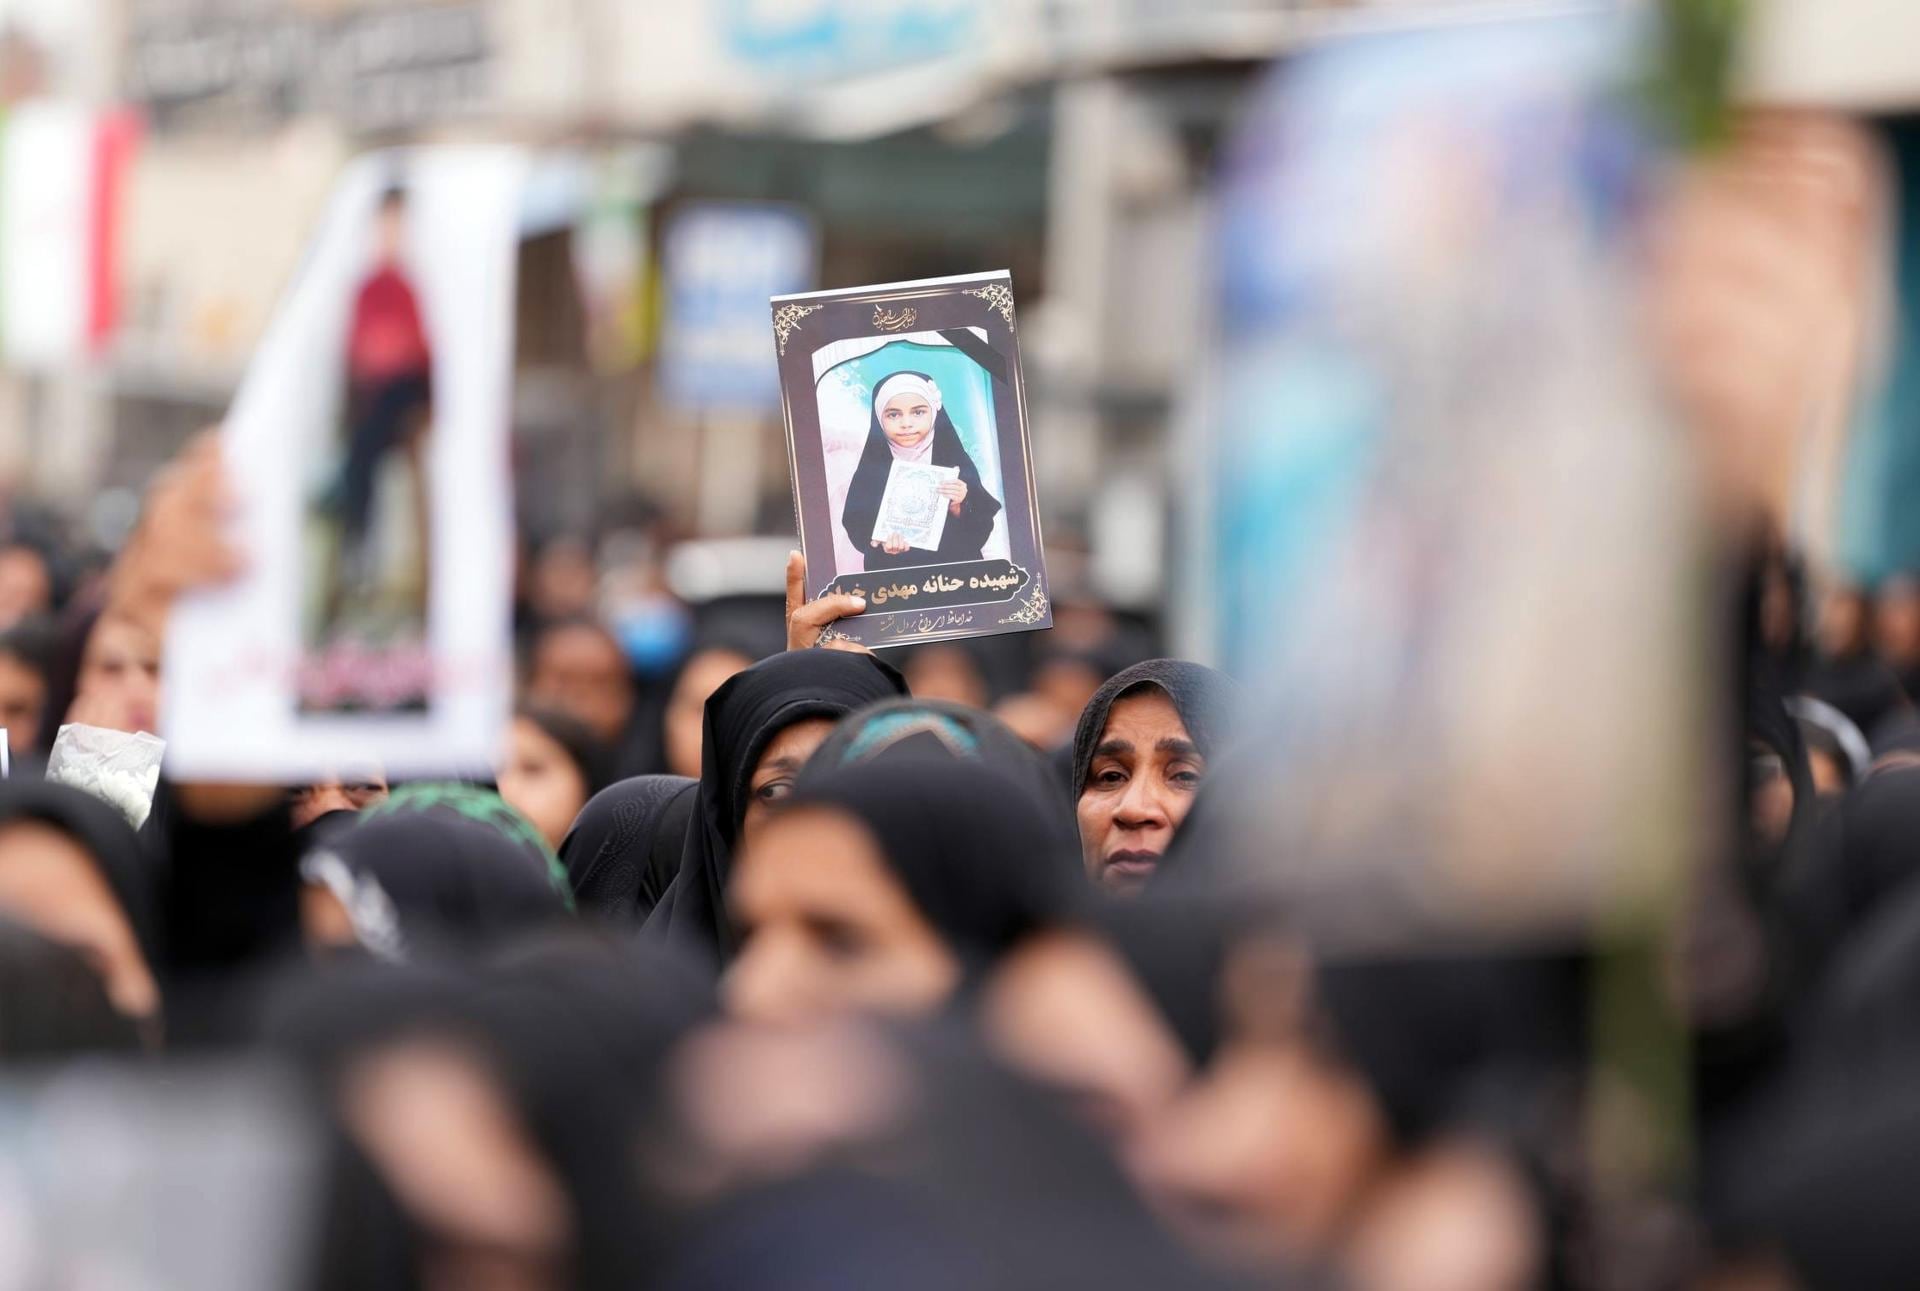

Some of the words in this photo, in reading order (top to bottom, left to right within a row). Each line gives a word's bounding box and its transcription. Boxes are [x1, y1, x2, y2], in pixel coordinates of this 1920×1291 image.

[922, 574, 964, 593] حنانه
[969, 567, 1019, 591] شهیده
[871, 583, 918, 605] مهدی
